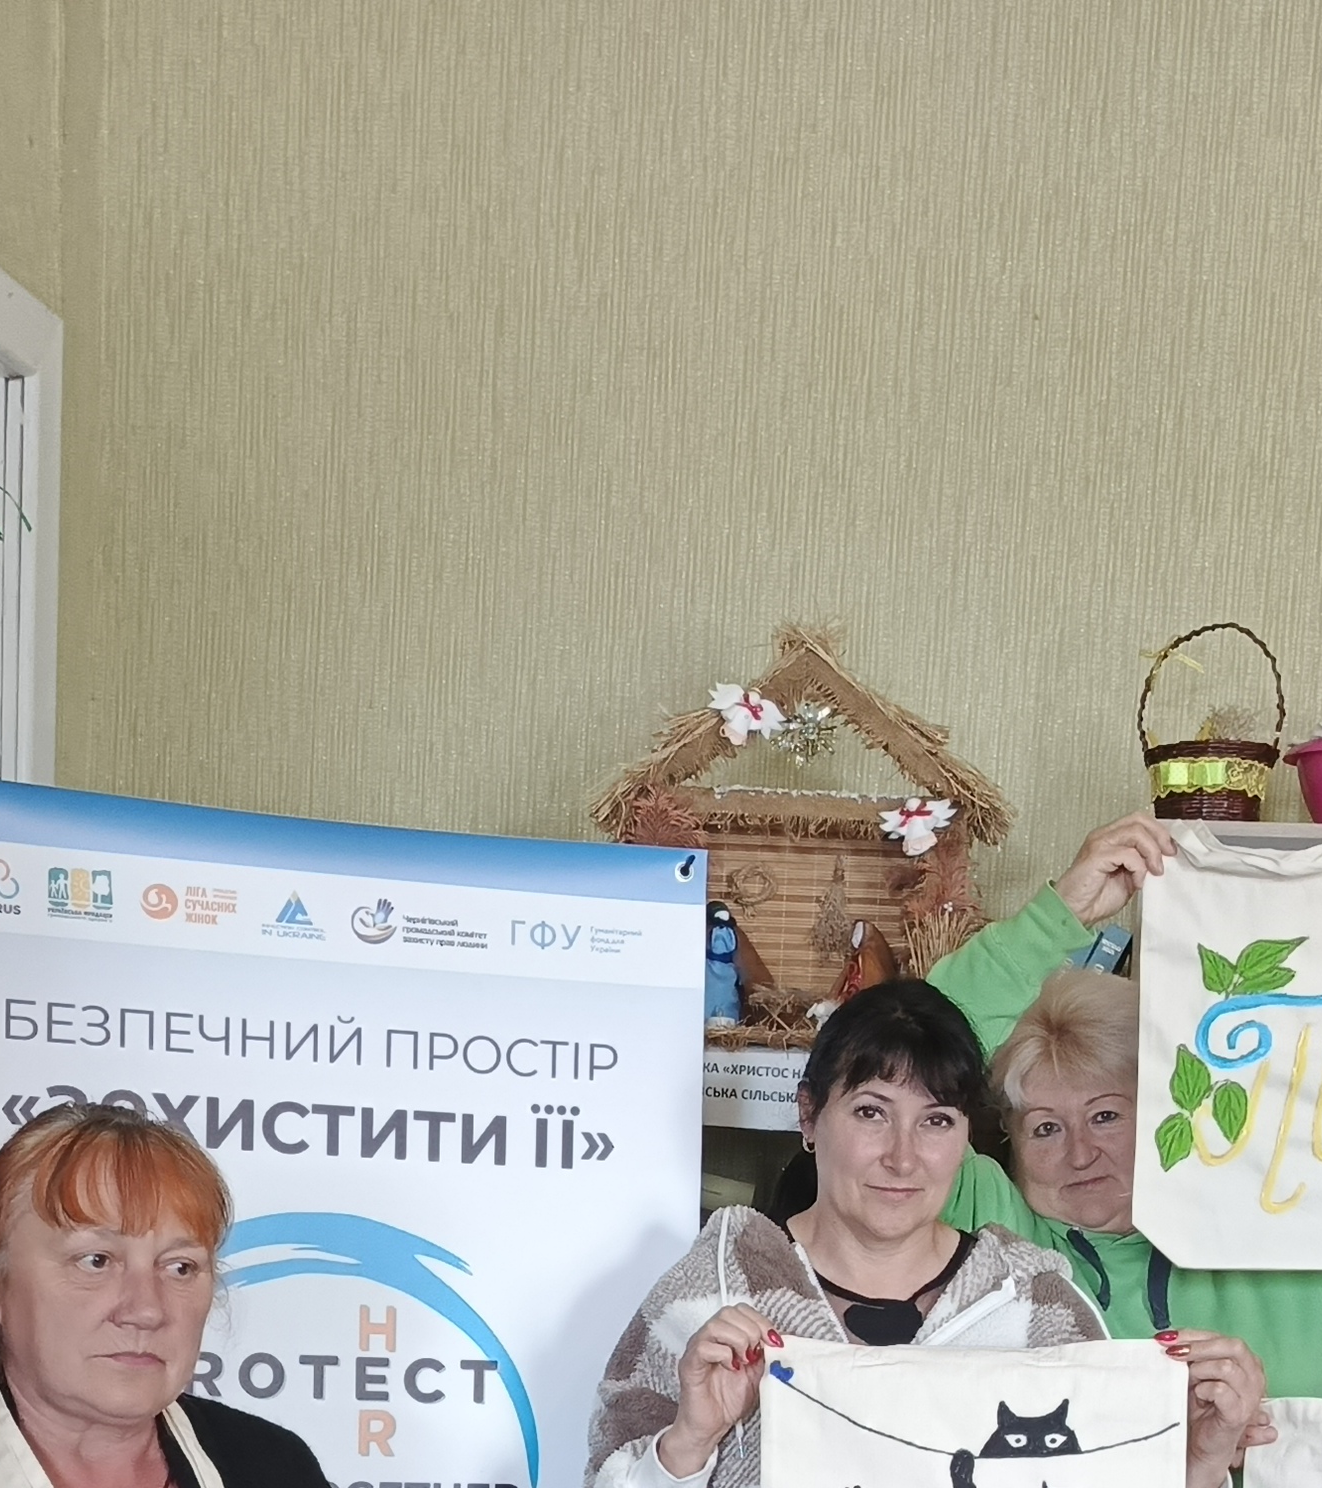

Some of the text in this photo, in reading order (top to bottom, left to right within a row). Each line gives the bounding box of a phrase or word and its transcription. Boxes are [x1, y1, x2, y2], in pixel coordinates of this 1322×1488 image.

[184, 898, 237, 914] СУЧАСНИХ
[185, 912, 218, 926] ЖІНОК
[276, 931, 327, 942] UKRAINE
[511, 919, 582, 951] ГФУ
[3, 997, 620, 1082] БЕЗПЕЧНИЙ ПРОСТІР
[703, 1062, 720, 1074] КА
[722, 1062, 790, 1080] «ХРИСТОС
[530, 1103, 615, 1171] ЇЇ»
[191, 1350, 499, 1404] ROTECT
